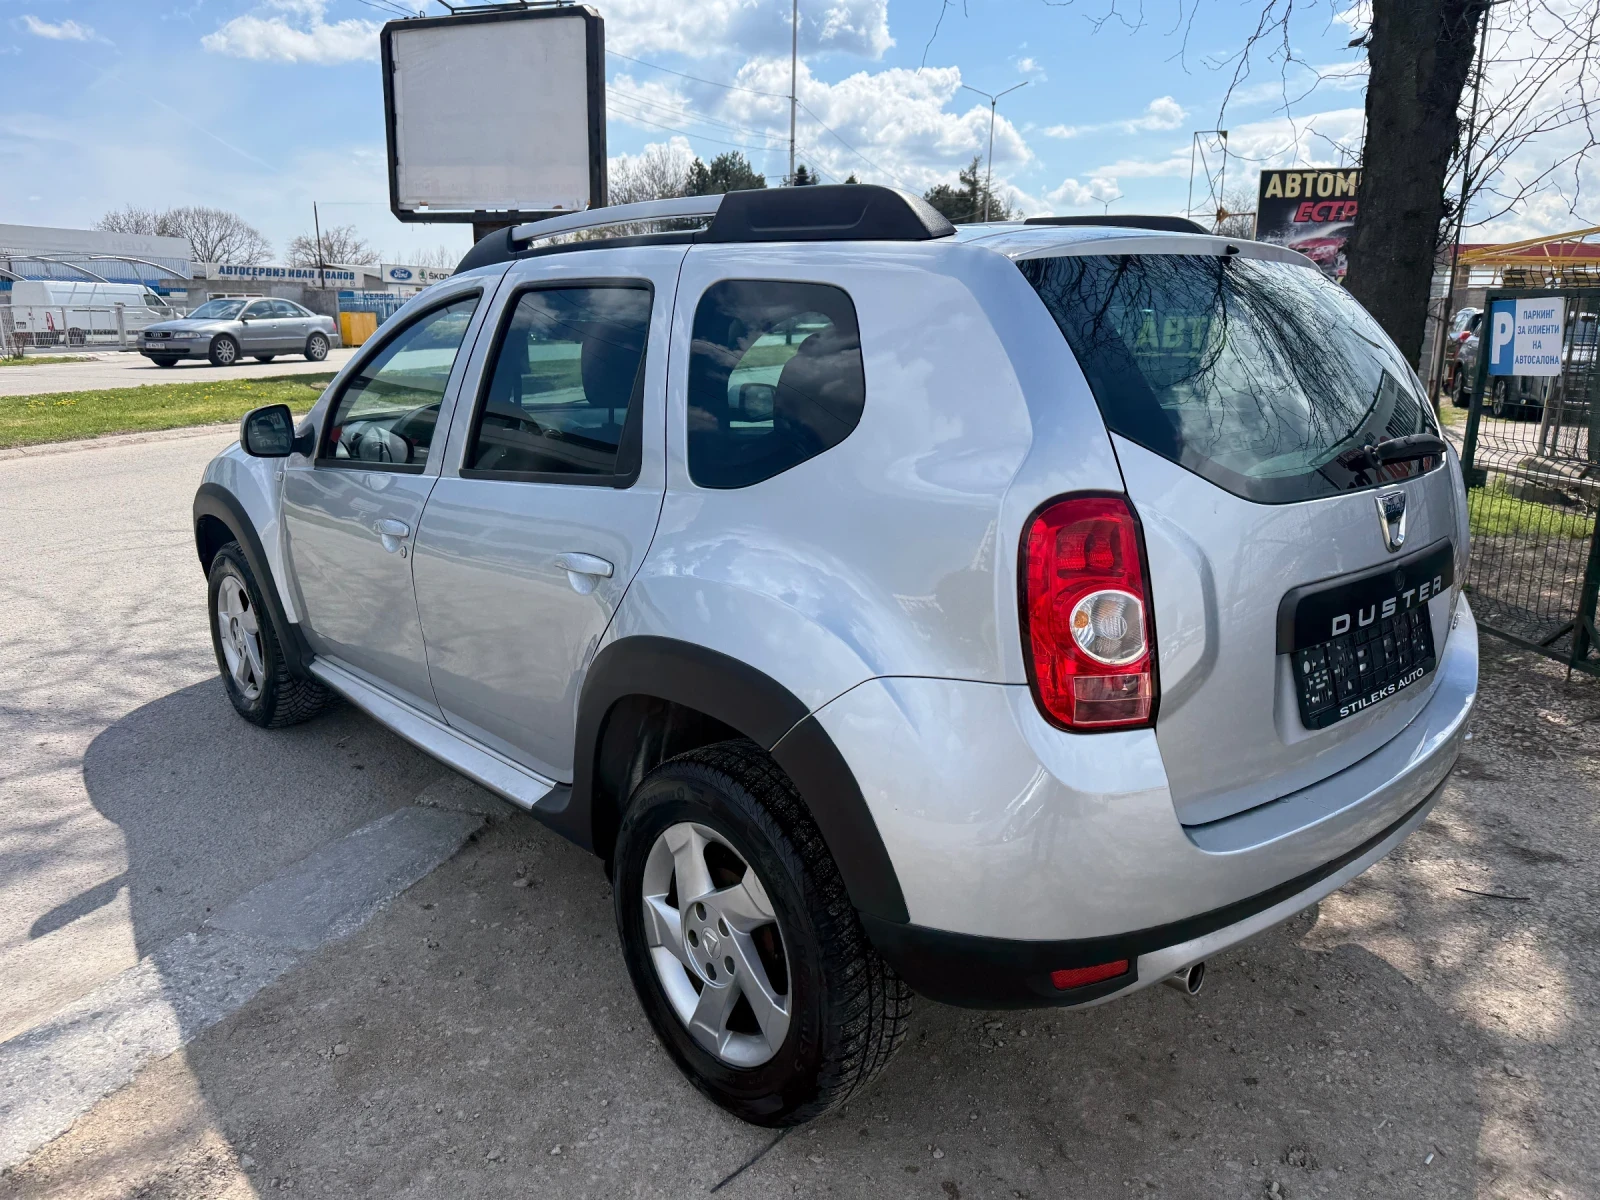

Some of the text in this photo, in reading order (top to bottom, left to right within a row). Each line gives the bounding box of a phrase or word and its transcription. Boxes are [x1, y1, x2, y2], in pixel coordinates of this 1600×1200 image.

[1264, 171, 1361, 198] АВТОМ
[1293, 201, 1358, 222] ЕСТР
[218, 266, 286, 277] АВТОСЕРВИЗ
[288, 269, 314, 279] ИВАН
[428, 271, 450, 280] ŠKOD
[1523, 309, 1555, 319] ПАРКИНГ
[1517, 324, 1559, 335] ЗА КЛИЕНТИ
[1532, 340, 1542, 350] НА
[1515, 355, 1559, 364] АВТОСАЛОНА
[1331, 575, 1442, 637] DUSTER
[1339, 667, 1424, 718] STILEKS AUTO
